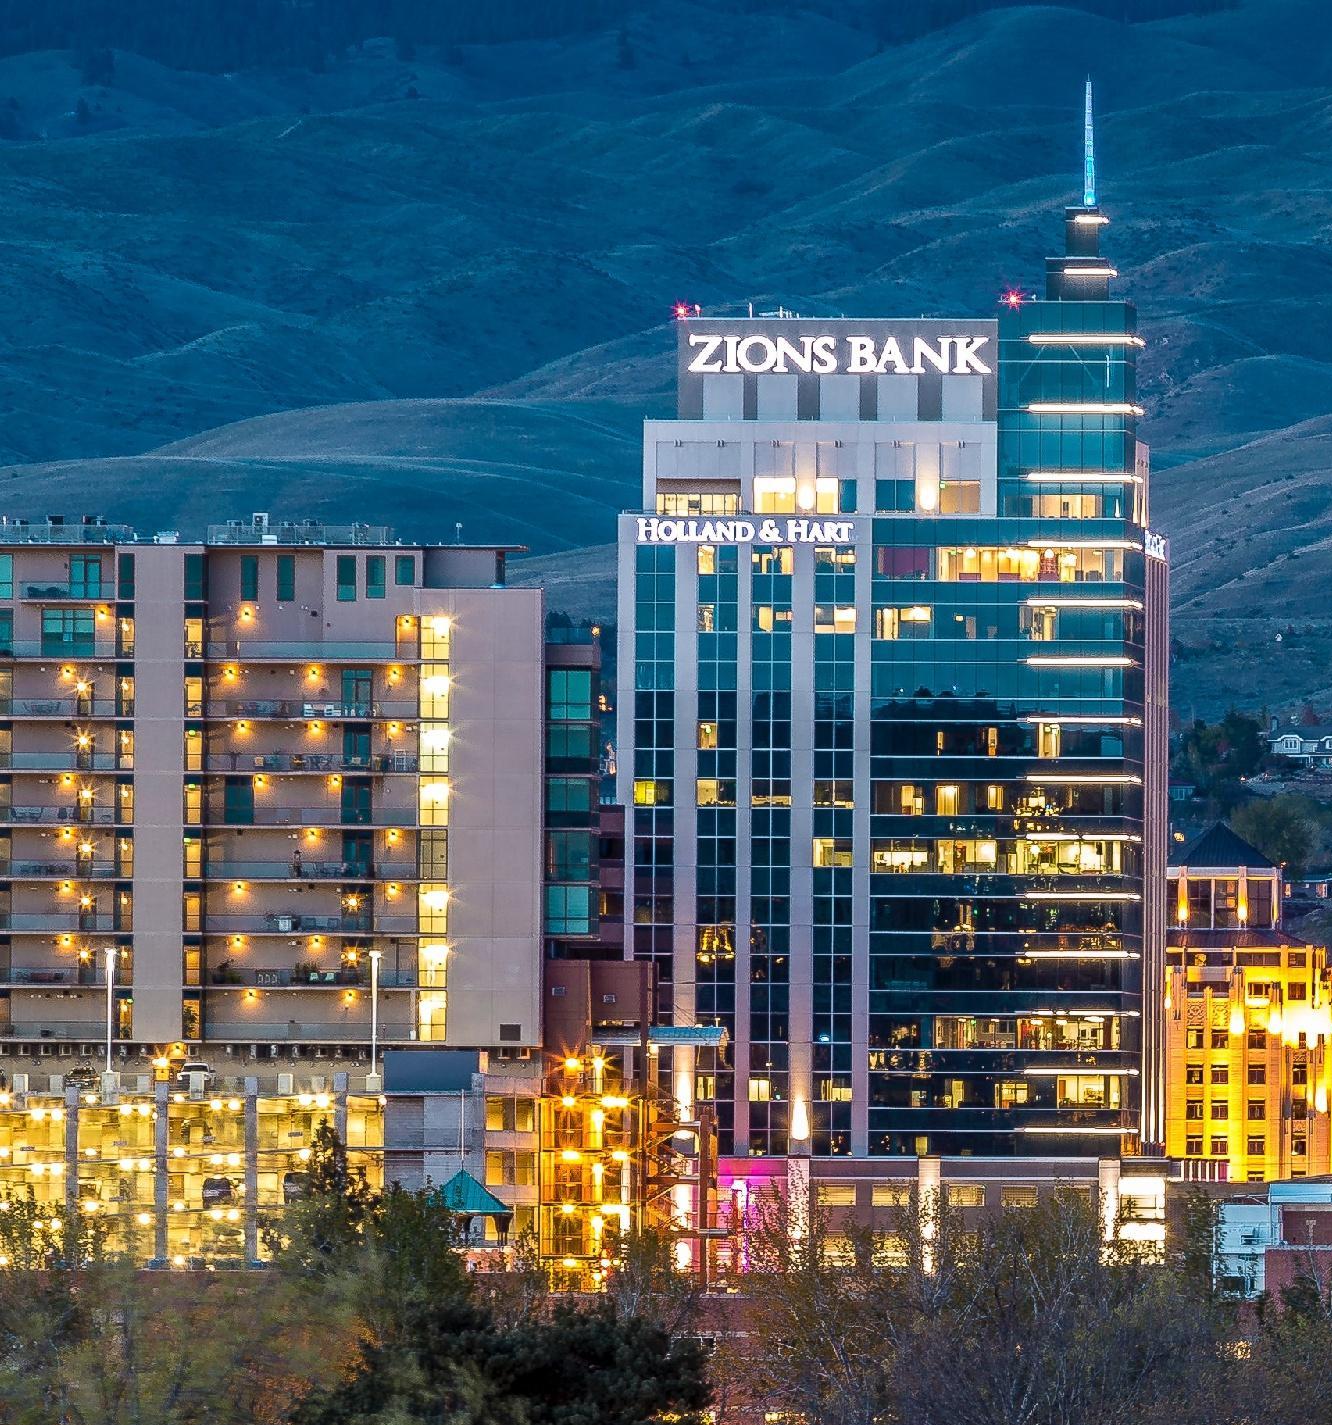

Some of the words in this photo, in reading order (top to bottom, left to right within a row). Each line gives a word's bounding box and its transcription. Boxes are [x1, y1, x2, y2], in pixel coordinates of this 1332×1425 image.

[687, 333, 839, 374] ZIONS
[845, 335, 992, 374] BANK
[636, 517, 755, 542] HOLLAND
[758, 518, 784, 542] &
[786, 518, 855, 542] HART
